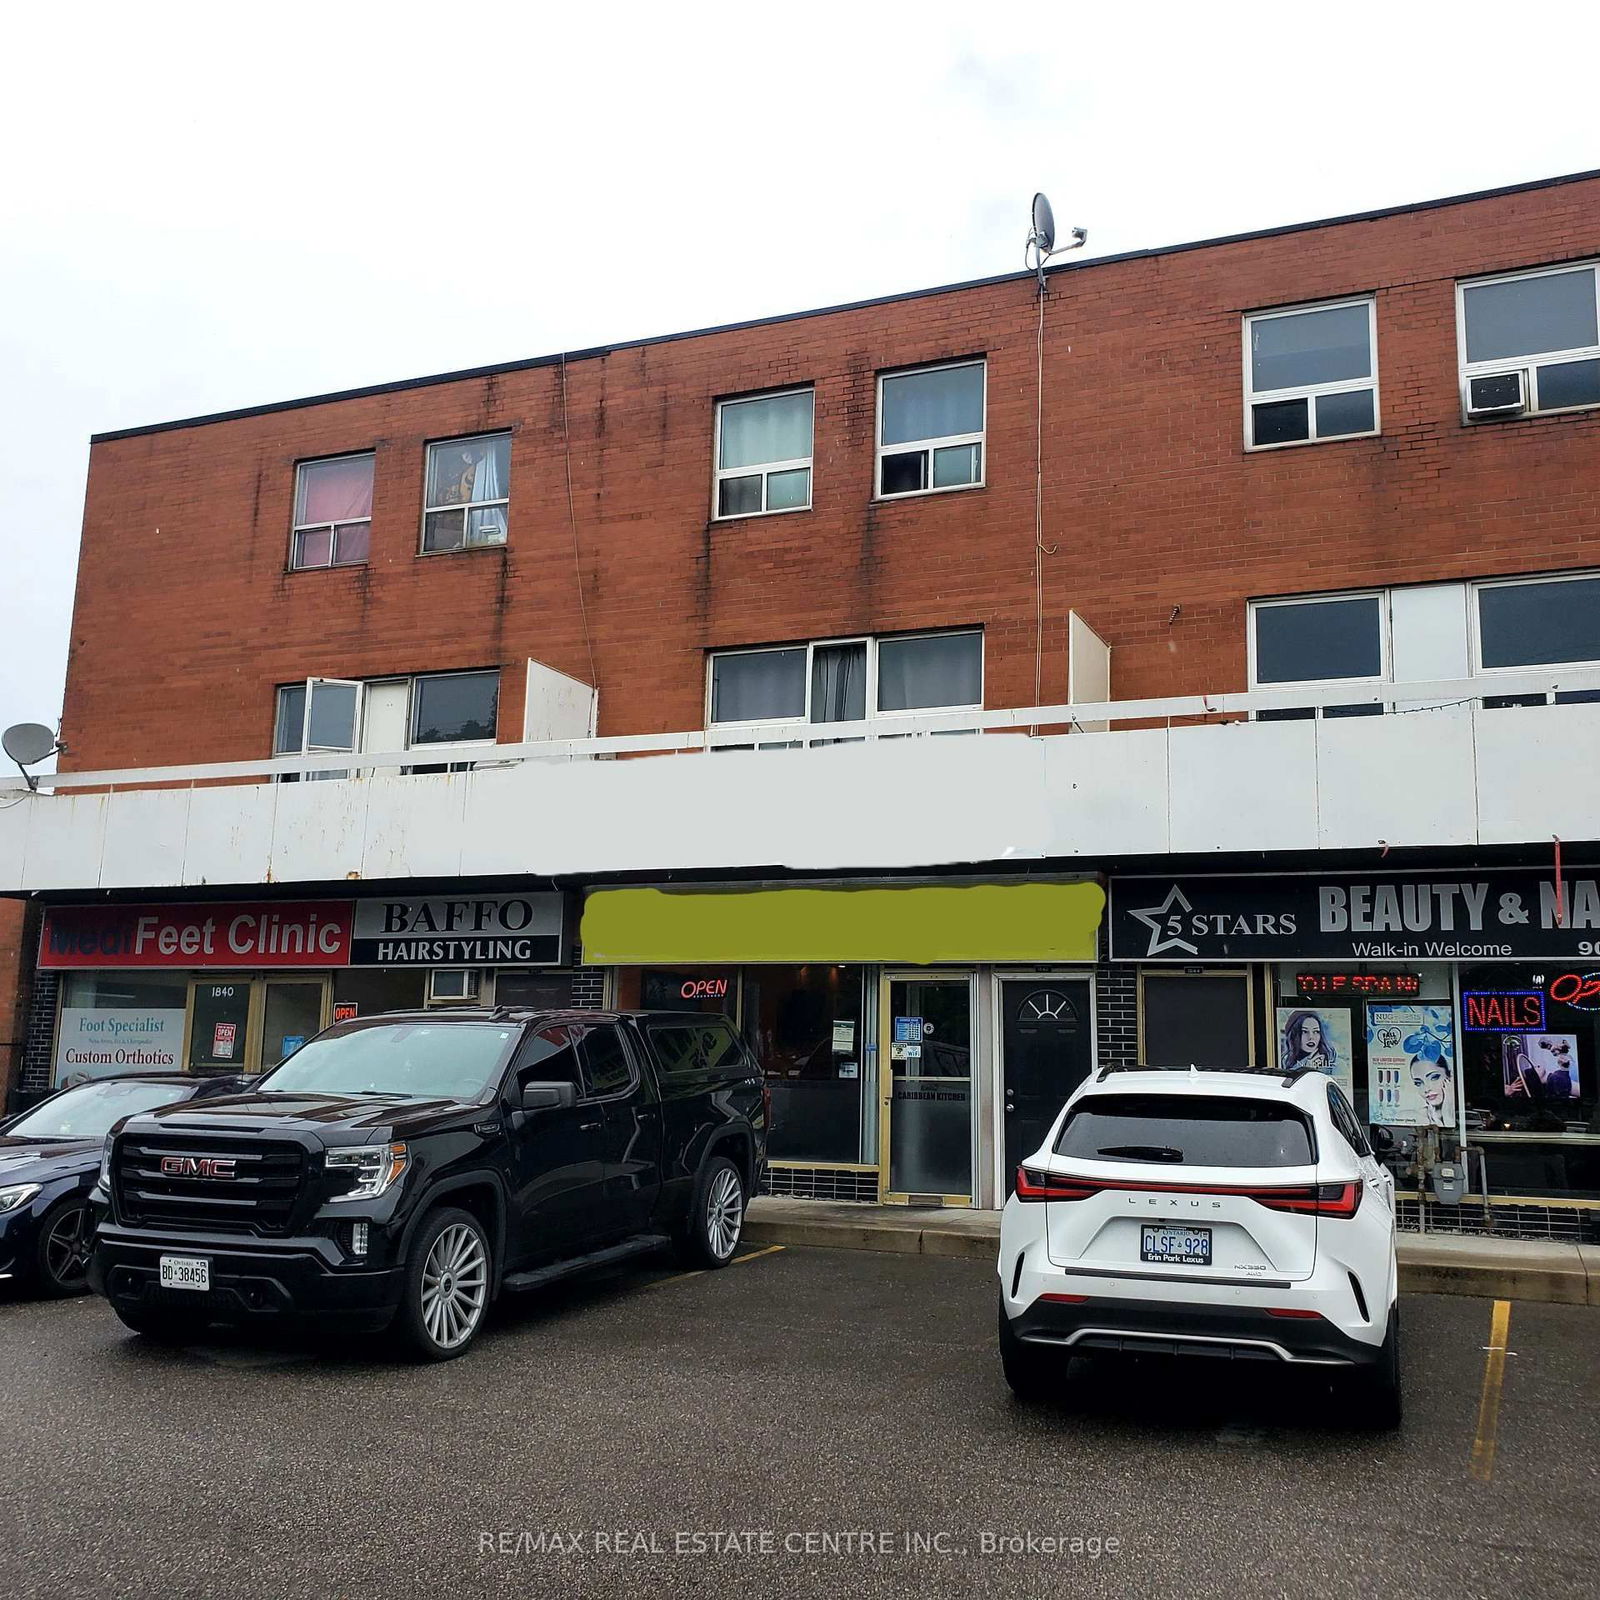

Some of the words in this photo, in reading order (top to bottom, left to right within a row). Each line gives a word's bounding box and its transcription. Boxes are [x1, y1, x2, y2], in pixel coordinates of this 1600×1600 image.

[380, 899, 533, 934] BAFFO
[1318, 883, 1489, 932] BEAUTY
[1498, 892, 1530, 924] &
[1167, 915, 1183, 936] 5
[1191, 913, 1297, 936] STARS
[134, 916, 216, 955] Feet
[227, 913, 342, 955] Clinic
[377, 940, 531, 961] HAIRSTYLING
[1352, 942, 1419, 957] Walk-in
[1424, 941, 1512, 957] Welcome
[212, 986, 234, 998] 1840
[681, 979, 728, 998] OPEN
[335, 1007, 356, 1020] OPEN
[1375, 1013, 1421, 1021] NUGESIS
[1468, 997, 1541, 1026] NAILS
[79, 1017, 105, 1032] Foot
[108, 1017, 165, 1036] Specialist
[217, 1028, 233, 1037] OPEN
[65, 1048, 112, 1064] Custom
[115, 1048, 174, 1065] Orthotics
[898, 1092, 935, 1100] CARIBBEAN
[937, 1093, 966, 1101] KITCHEN
[161, 1156, 236, 1178] GMC
[1128, 1198, 1221, 1208] LEXUS
[1144, 1235, 1176, 1254] CLSF
[1184, 1237, 1209, 1255] 928
[1147, 1253, 1162, 1261] Erin
[1163, 1254, 1181, 1262] Park
[1182, 1256, 1204, 1264] Lexus
[162, 1265, 173, 1280] BD
[178, 1267, 207, 1283] 38456
